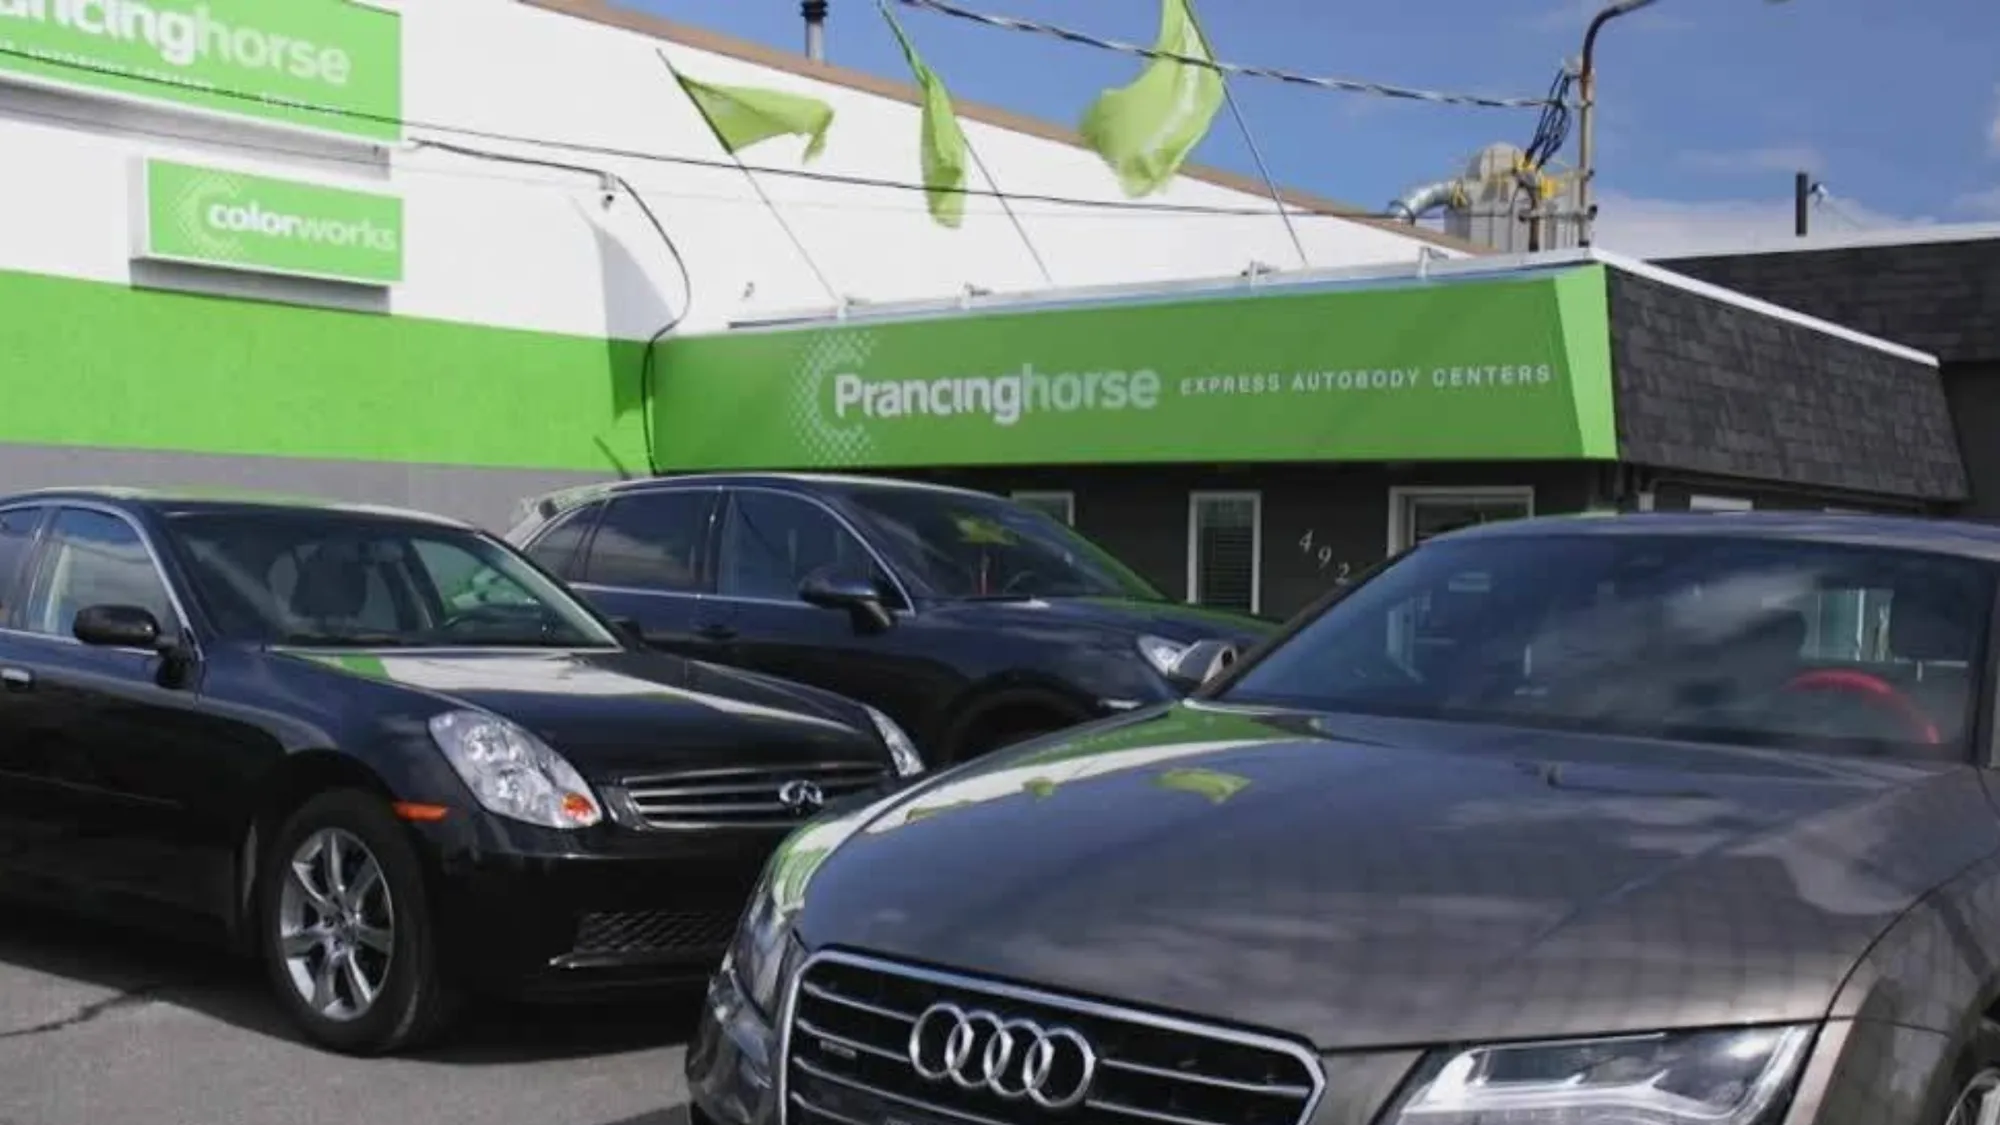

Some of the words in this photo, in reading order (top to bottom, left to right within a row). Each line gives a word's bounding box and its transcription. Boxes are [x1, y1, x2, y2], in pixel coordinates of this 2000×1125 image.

[208, 200, 396, 250] colorworks
[834, 363, 1160, 425] Prancinghorse
[1180, 373, 1280, 396] EXPRESS
[1292, 368, 1420, 393] AUTOBODY
[1433, 364, 1551, 388] CENTERS
